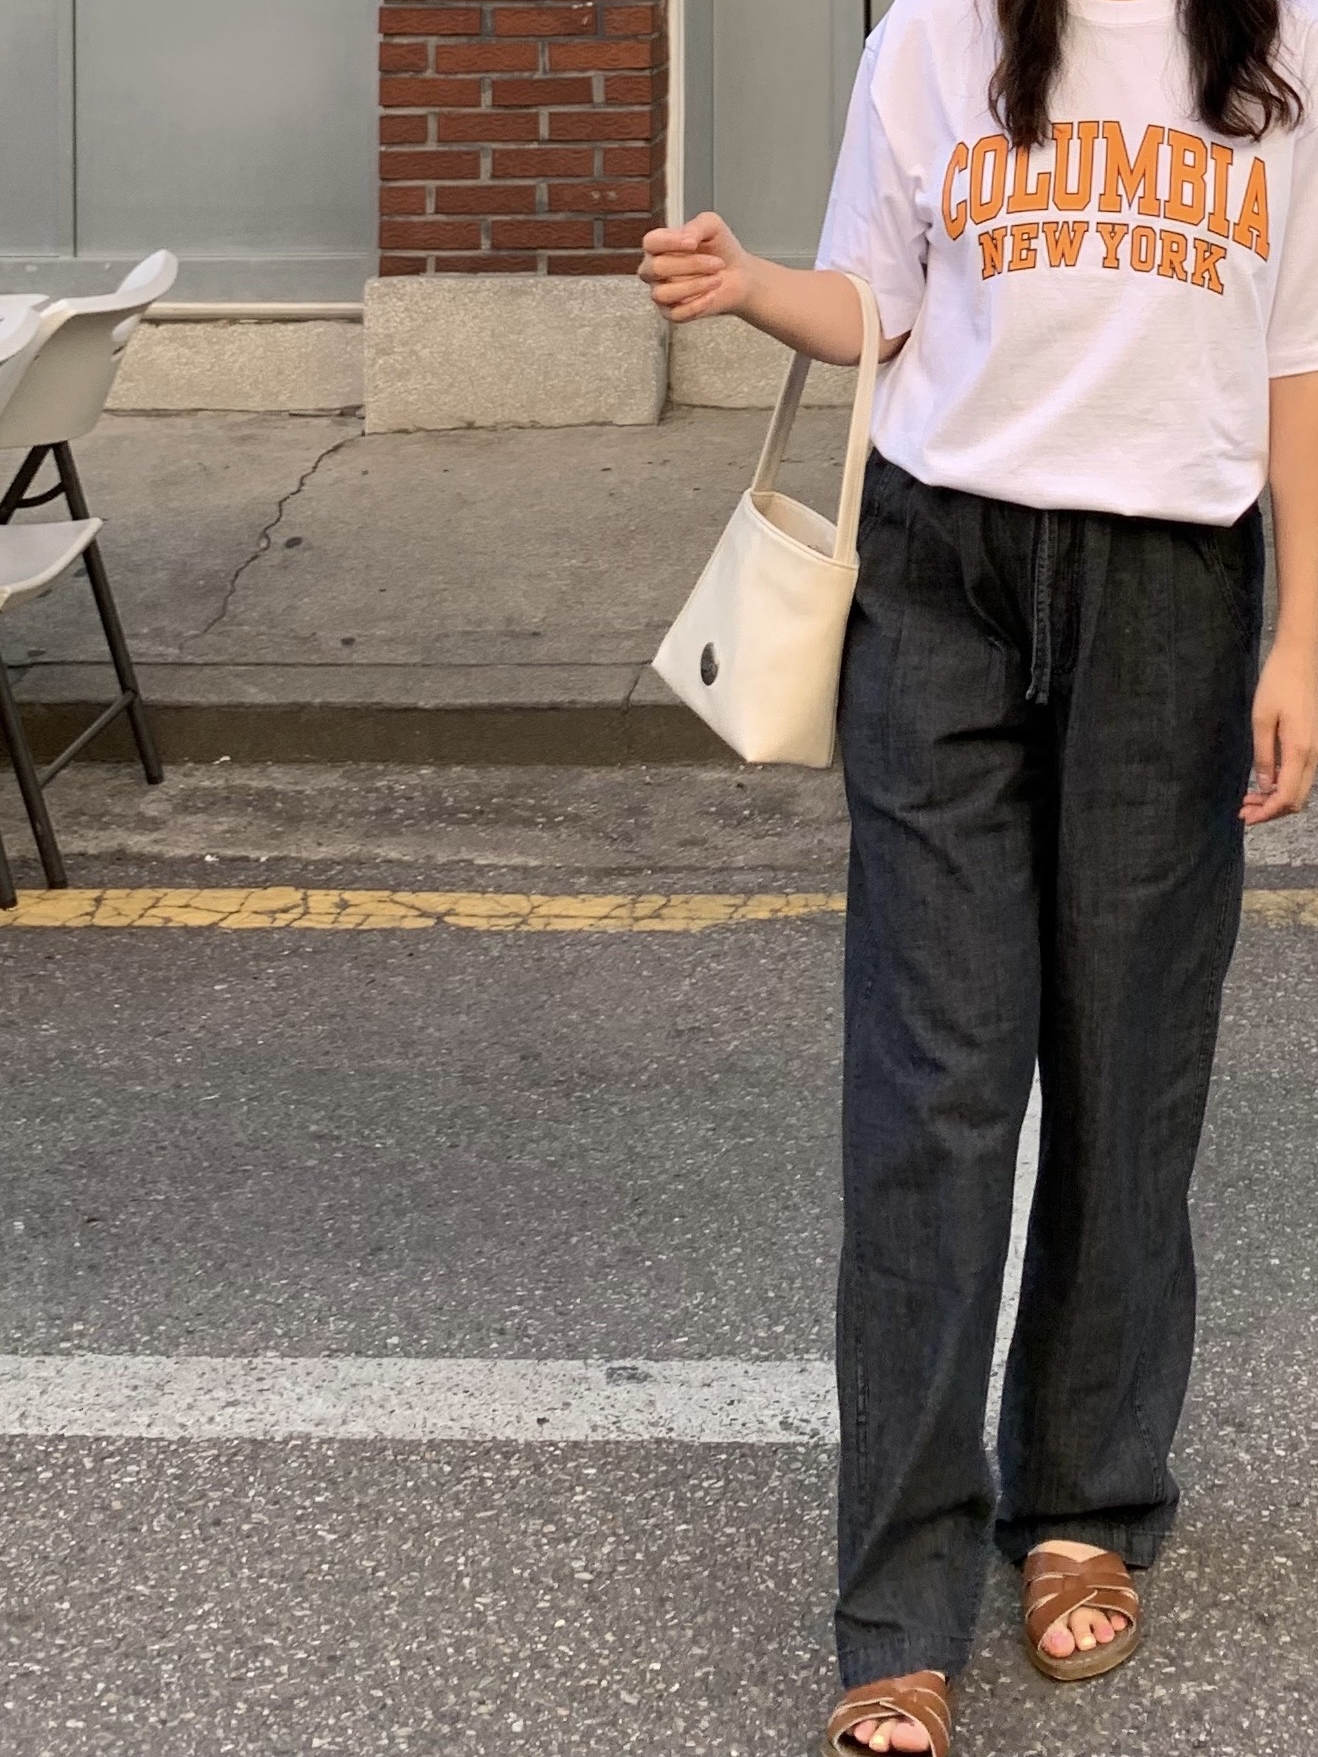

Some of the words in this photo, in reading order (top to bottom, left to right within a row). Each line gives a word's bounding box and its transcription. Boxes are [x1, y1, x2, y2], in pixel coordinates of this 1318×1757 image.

[941, 120, 1270, 262] COLUMBIA
[977, 220, 1090, 282] NEW
[1095, 222, 1228, 296] YORK
